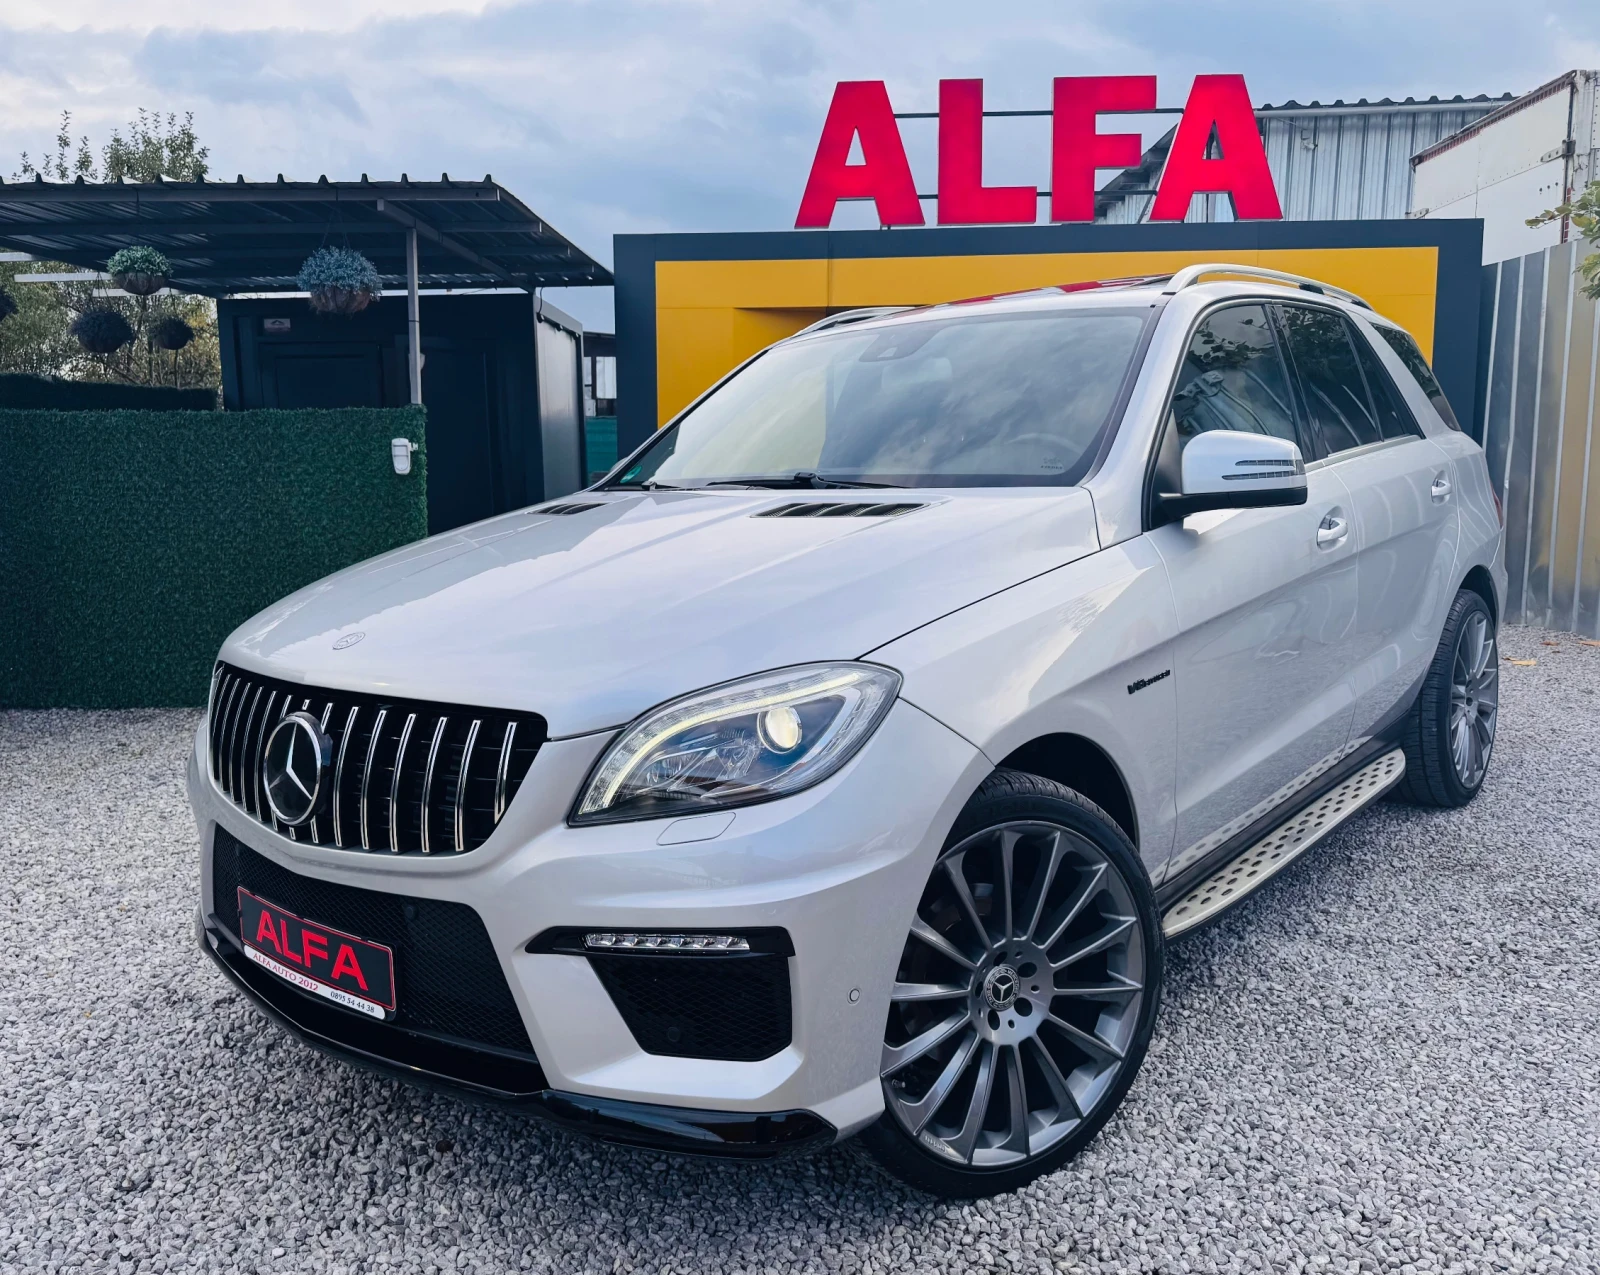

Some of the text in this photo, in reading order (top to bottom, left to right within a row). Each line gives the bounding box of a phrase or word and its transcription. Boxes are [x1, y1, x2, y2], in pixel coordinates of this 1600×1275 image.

[794, 74, 1284, 229] ALFA
[253, 953, 319, 991] ALFA AUTO 2012
[256, 909, 369, 991] ALFA
[330, 991, 375, 1013] 0895 54 44 38
